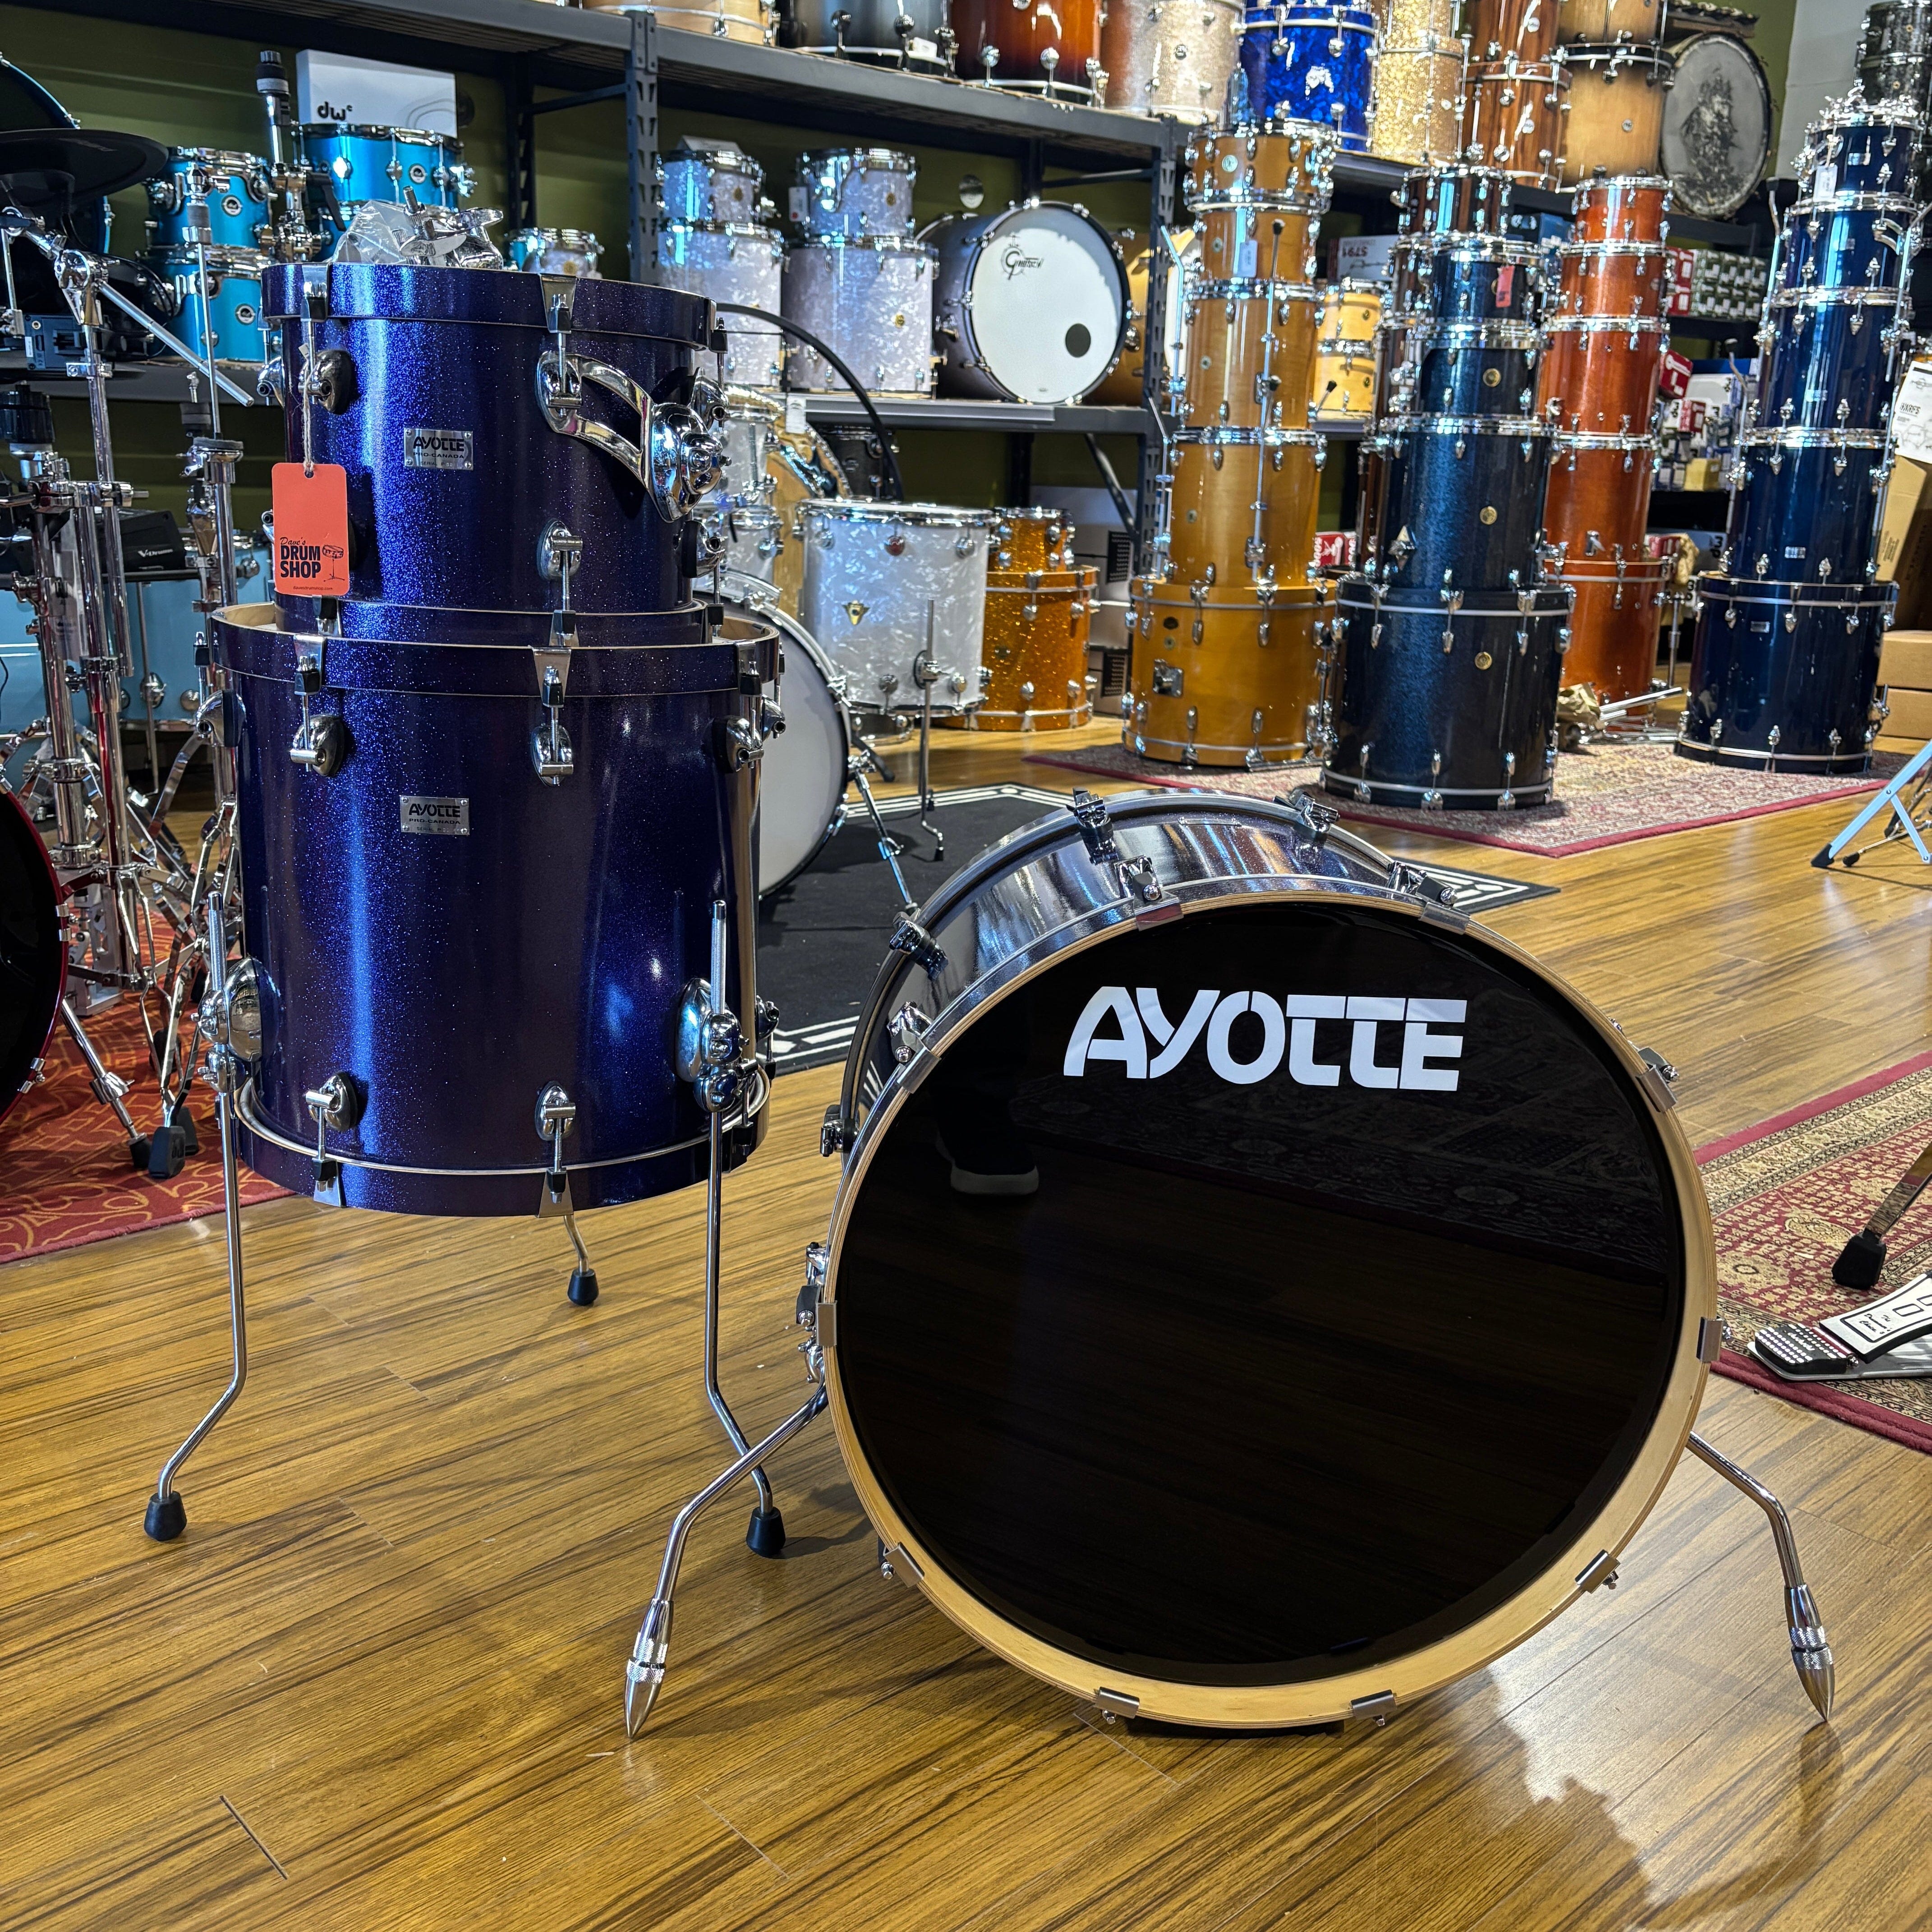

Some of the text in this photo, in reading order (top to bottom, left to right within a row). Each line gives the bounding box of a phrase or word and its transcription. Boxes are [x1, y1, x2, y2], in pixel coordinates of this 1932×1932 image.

[413, 436, 465, 452] AYOTTE
[280, 537, 306, 546] Dave's
[281, 545, 321, 561] DRUM
[280, 561, 321, 579] SHOP
[409, 803, 460, 818] AYOTTE
[1063, 986, 1467, 1091] AYOTTE
